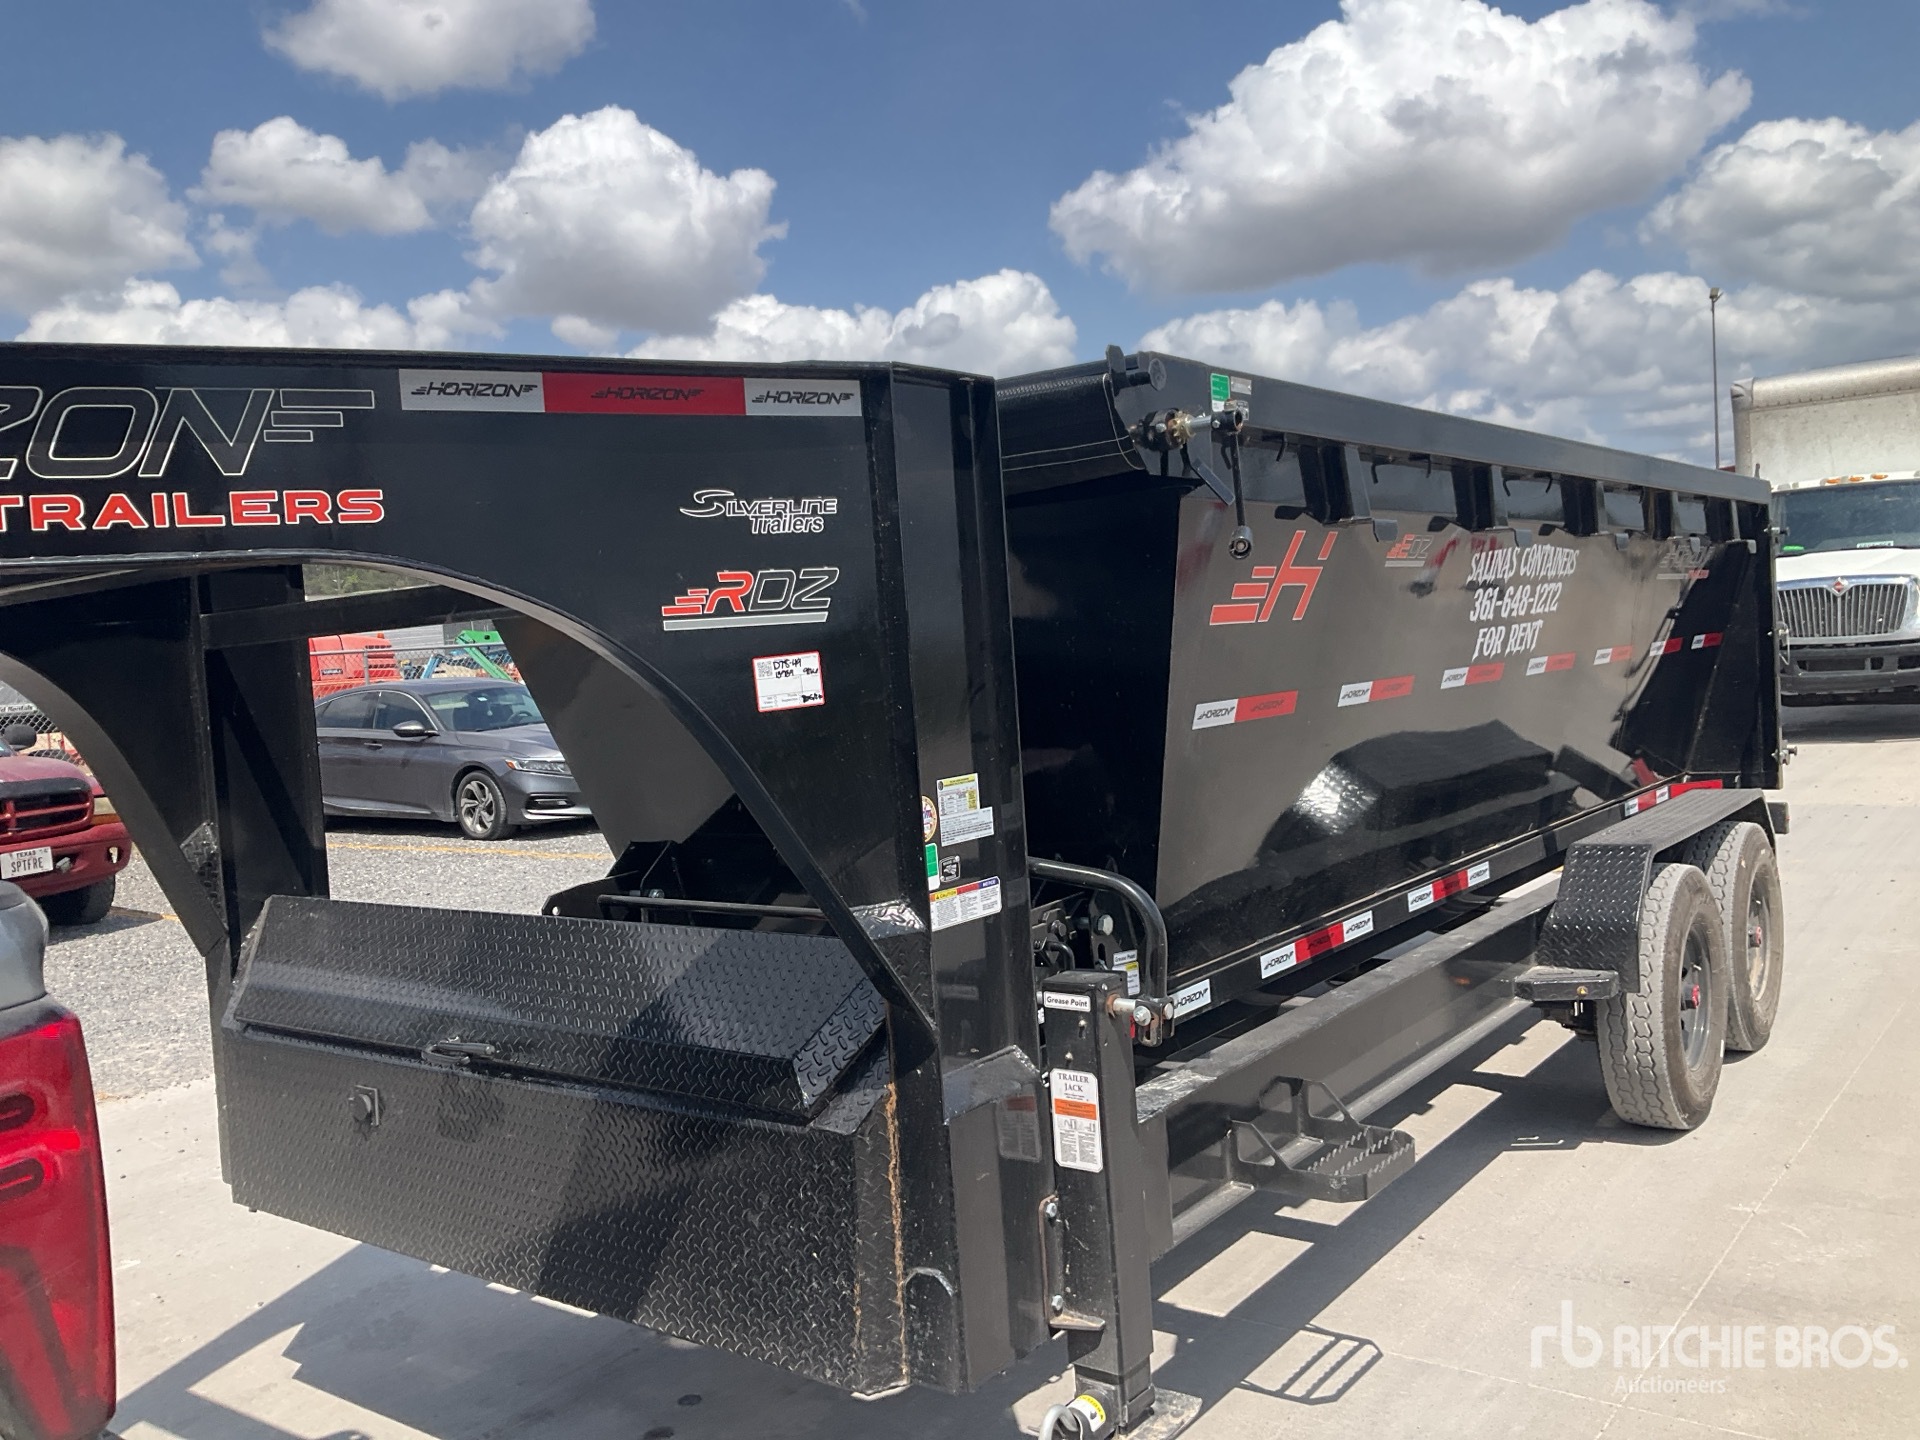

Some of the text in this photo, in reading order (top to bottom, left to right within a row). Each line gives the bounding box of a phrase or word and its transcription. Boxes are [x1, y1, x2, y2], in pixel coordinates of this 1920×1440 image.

[426, 381, 525, 398] HORIZON
[604, 386, 692, 401] HORIZON
[764, 390, 845, 405] HORIZON
[680, 490, 838, 517] SILVERLINE
[750, 515, 824, 534] Trailers
[1466, 543, 1580, 586] SALINAS CONTAINERS
[704, 566, 840, 613] RDZ
[1469, 582, 1562, 622] 361-648-1272
[1471, 619, 1544, 662] FOR RENT
[16, 850, 36, 858] TEXAS
[1046, 996, 1088, 1007] Grease Point
[1057, 1072, 1089, 1083] TRAILER
[1064, 1082, 1084, 1093] JACK
